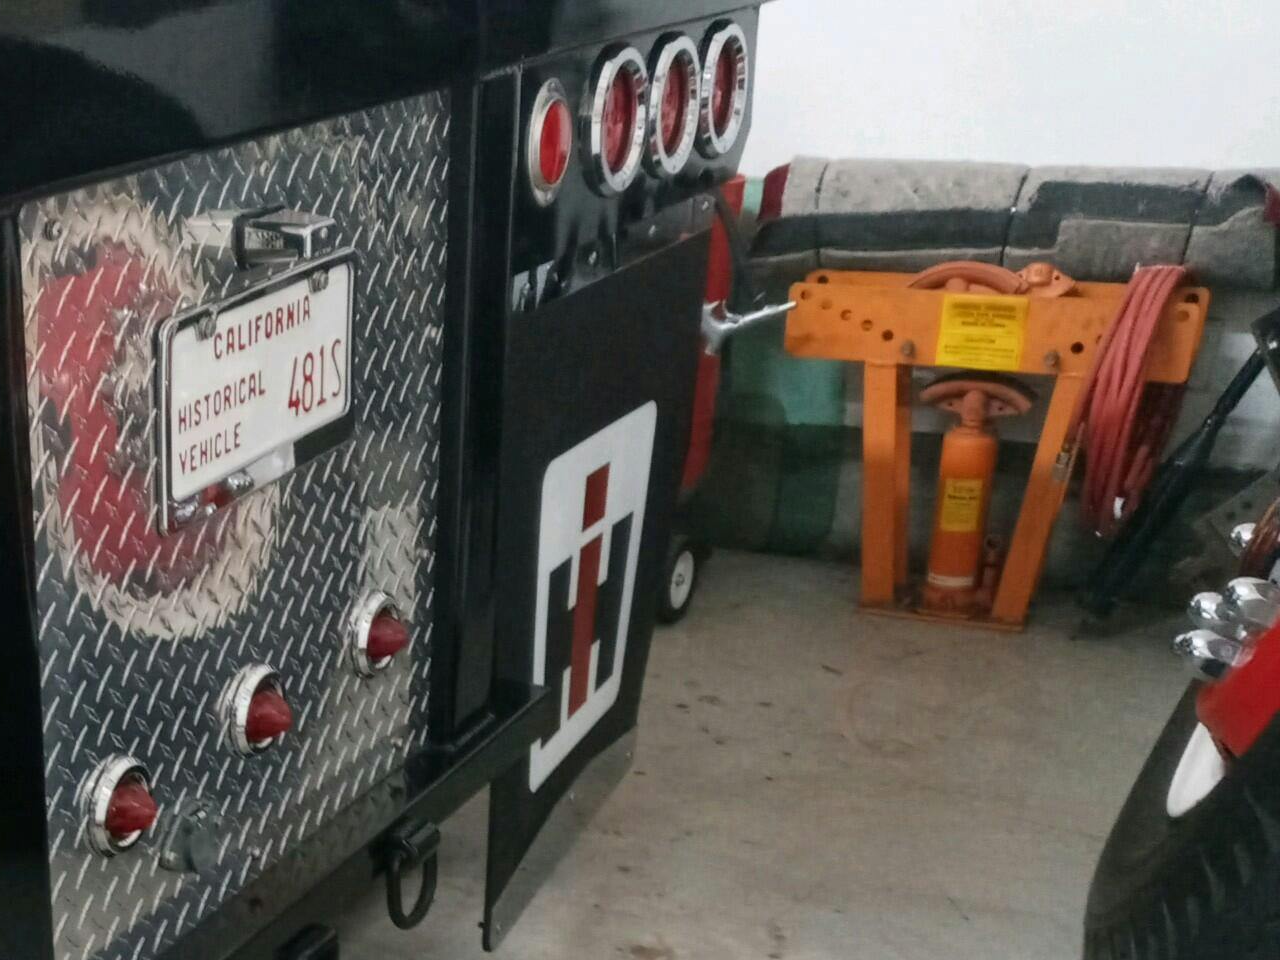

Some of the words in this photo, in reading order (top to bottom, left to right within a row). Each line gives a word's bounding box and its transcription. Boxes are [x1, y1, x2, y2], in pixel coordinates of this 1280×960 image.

[213, 295, 311, 360] CALIFORNIA
[178, 370, 267, 434] HISTORICAL
[179, 421, 241, 475] VEHICLE
